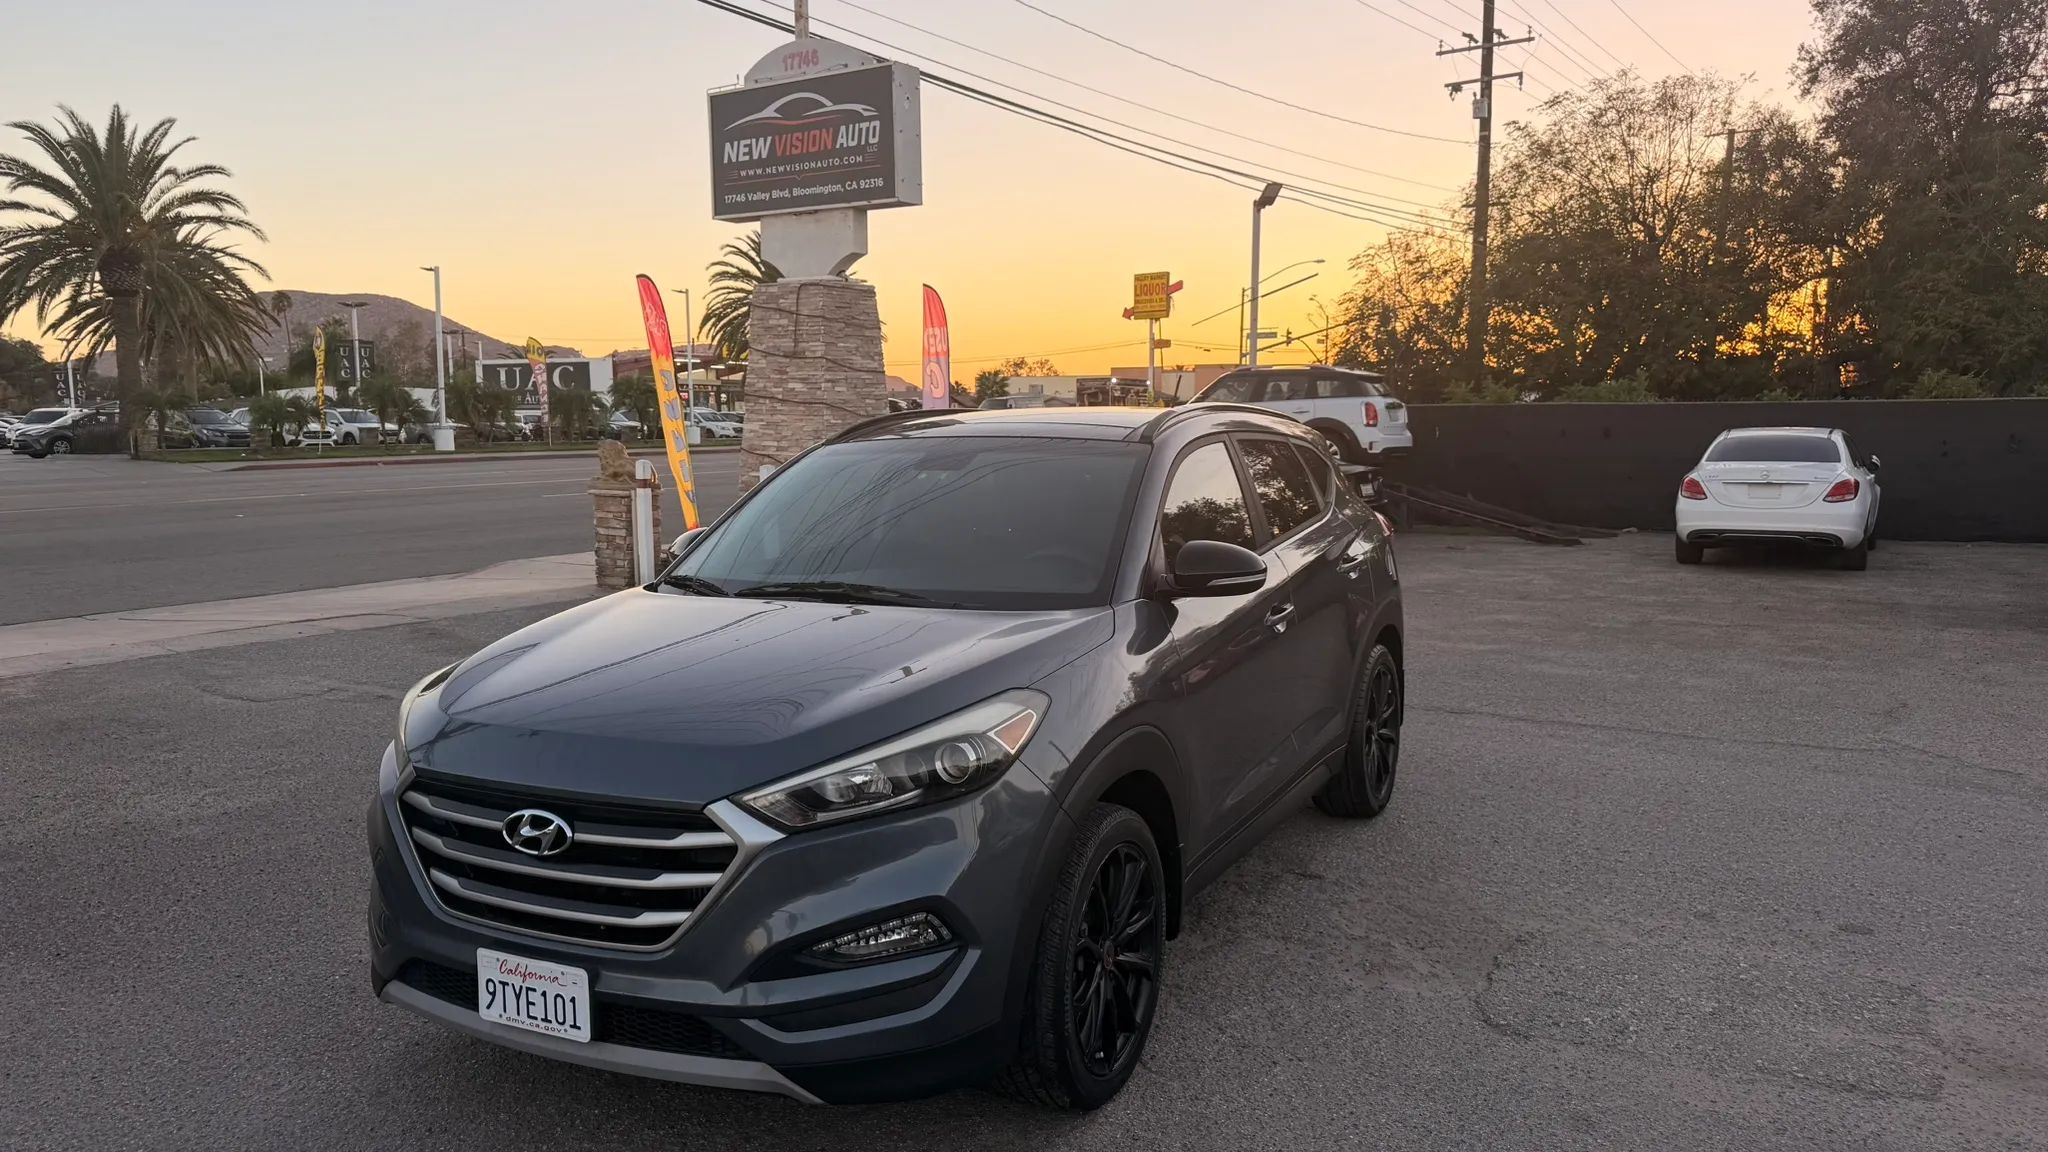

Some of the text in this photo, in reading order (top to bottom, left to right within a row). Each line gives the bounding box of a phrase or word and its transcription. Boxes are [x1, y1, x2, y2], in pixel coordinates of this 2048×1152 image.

[782, 49, 819, 72] 17746
[723, 120, 881, 164] NEW VISION AUTO
[866, 144, 878, 153] LLC
[739, 154, 864, 178] WWW.NEWVISIONAUTO.COM
[724, 177, 884, 204] 17746 Valley Blvd, Bloomington, CA 92316
[1134, 282, 1167, 297] LIQUOR
[339, 346, 351, 378] UAC
[360, 347, 371, 379] UAC
[55, 373, 67, 397] UAC
[499, 958, 567, 987] California
[485, 977, 582, 1031] 9TYE101
[505, 1015, 563, 1033] dmv.ca.gov
